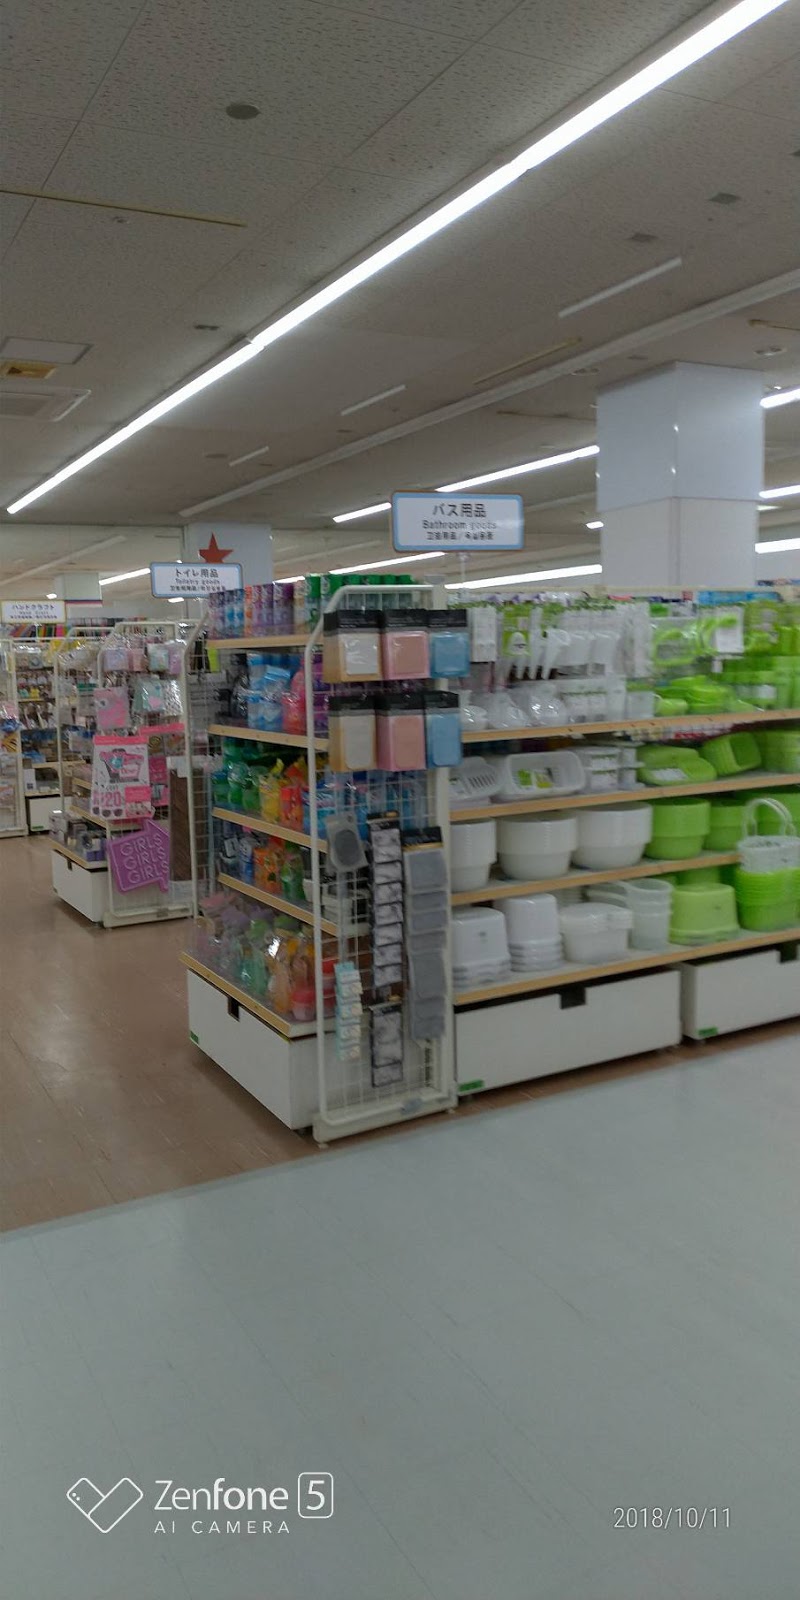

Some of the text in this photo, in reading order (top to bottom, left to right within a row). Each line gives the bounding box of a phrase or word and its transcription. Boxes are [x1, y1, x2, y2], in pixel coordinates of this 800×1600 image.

[432, 503, 487, 518] バス用品
[422, 519, 498, 531] Bathroom goods
[175, 568, 219, 578] トイレ用品
[120, 833, 163, 855] GIRLS
[124, 847, 167, 870] GIRLS
[128, 861, 169, 884] GIRLS
